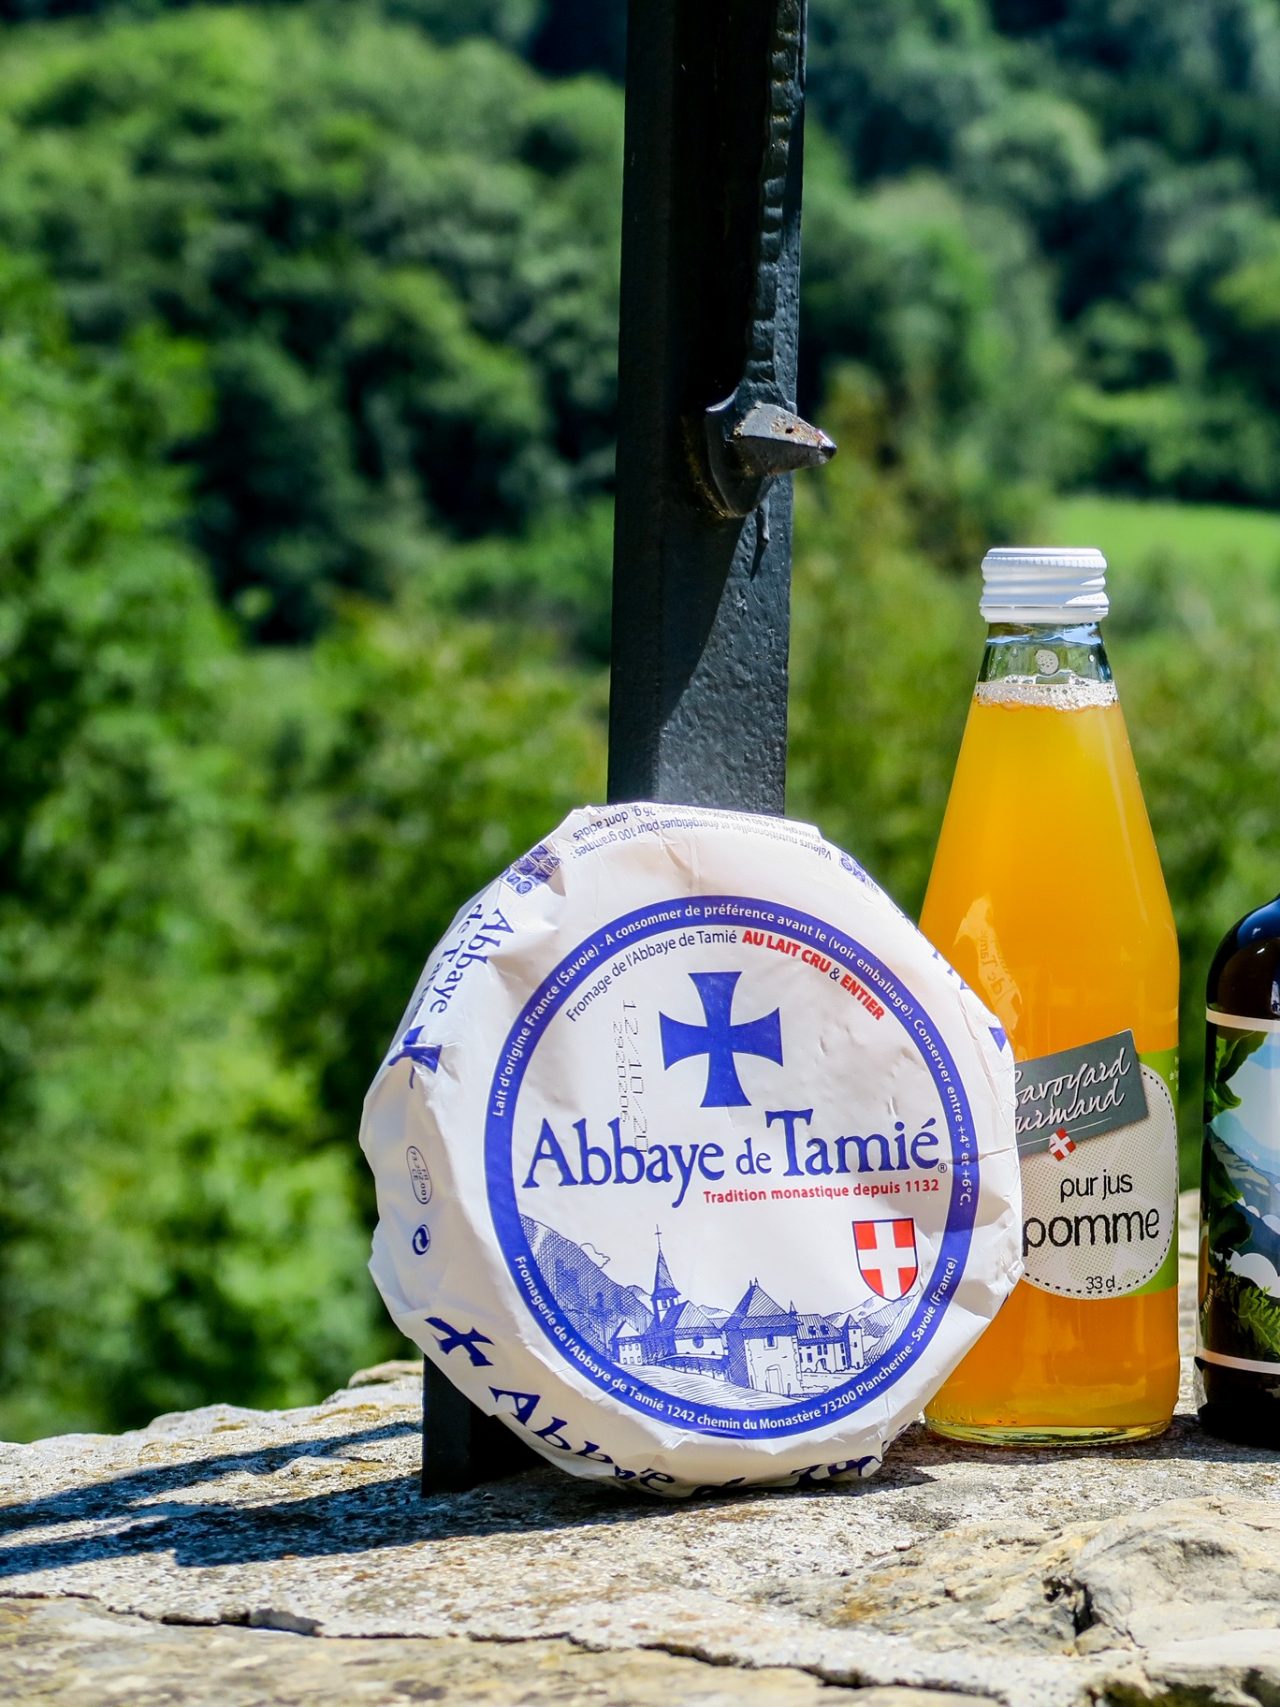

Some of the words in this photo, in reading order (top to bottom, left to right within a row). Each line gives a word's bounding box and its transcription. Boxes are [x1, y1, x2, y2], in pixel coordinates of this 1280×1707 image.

[604, 810, 629, 828] dont
[636, 818, 660, 834] pour
[574, 830, 618, 857] grammes
[618, 828, 638, 841] 100
[615, 907, 682, 939] consommer
[684, 904, 701, 917] de
[703, 902, 775, 922] préférence
[604, 933, 615, 946] A
[777, 914, 814, 937] avant
[814, 927, 827, 943] le
[428, 908, 515, 1015] Abbaye
[828, 936, 857, 961] (voir
[556, 943, 600, 988] (Savoie)
[565, 974, 612, 1023] Fromage
[611, 961, 628, 978] de
[624, 937, 677, 968] l'Abbaye
[678, 931, 696, 946] de
[696, 929, 738, 944] Tamié
[741, 929, 765, 947] AU
[765, 934, 802, 958] LAIT
[800, 948, 832, 974] CRU
[828, 966, 841, 982] &
[839, 972, 886, 1021] ENTIER
[855, 957, 914, 1021] emballage).
[524, 985, 560, 1027] France
[499, 1026, 532, 1088] d'origine
[913, 1018, 952, 1083] Conserver
[492, 1090, 508, 1117] Lait
[946, 1085, 963, 1122] entre
[521, 1115, 726, 1209] Abbaye
[735, 1136, 771, 1175] de
[765, 1107, 942, 1178] Tamié
[960, 1151, 970, 1166] et
[703, 1188, 767, 1205] Tradition
[770, 1183, 850, 1203] monastique
[853, 1181, 901, 1198] depuis
[905, 1177, 940, 1194] 1132
[1059, 1176, 1099, 1203] pur
[1101, 1168, 1133, 1201] jus
[1021, 1207, 1161, 1258] pomme
[1085, 1275, 1104, 1291] 33
[514, 1254, 558, 1327] Fromagerie
[553, 1323, 567, 1342] de
[565, 1336, 612, 1383] l'Abbaye
[611, 1375, 628, 1392] de
[628, 1385, 665, 1412] Tamié
[666, 1403, 695, 1423] 1242
[696, 1413, 741, 1431] chemin
[742, 1417, 758, 1431] du
[759, 1408, 822, 1430] Monastère
[820, 1390, 858, 1416] 73200
[854, 1344, 914, 1397] Plancherine
[911, 1304, 937, 1344] Savoie
[930, 1256, 959, 1308] (France)
